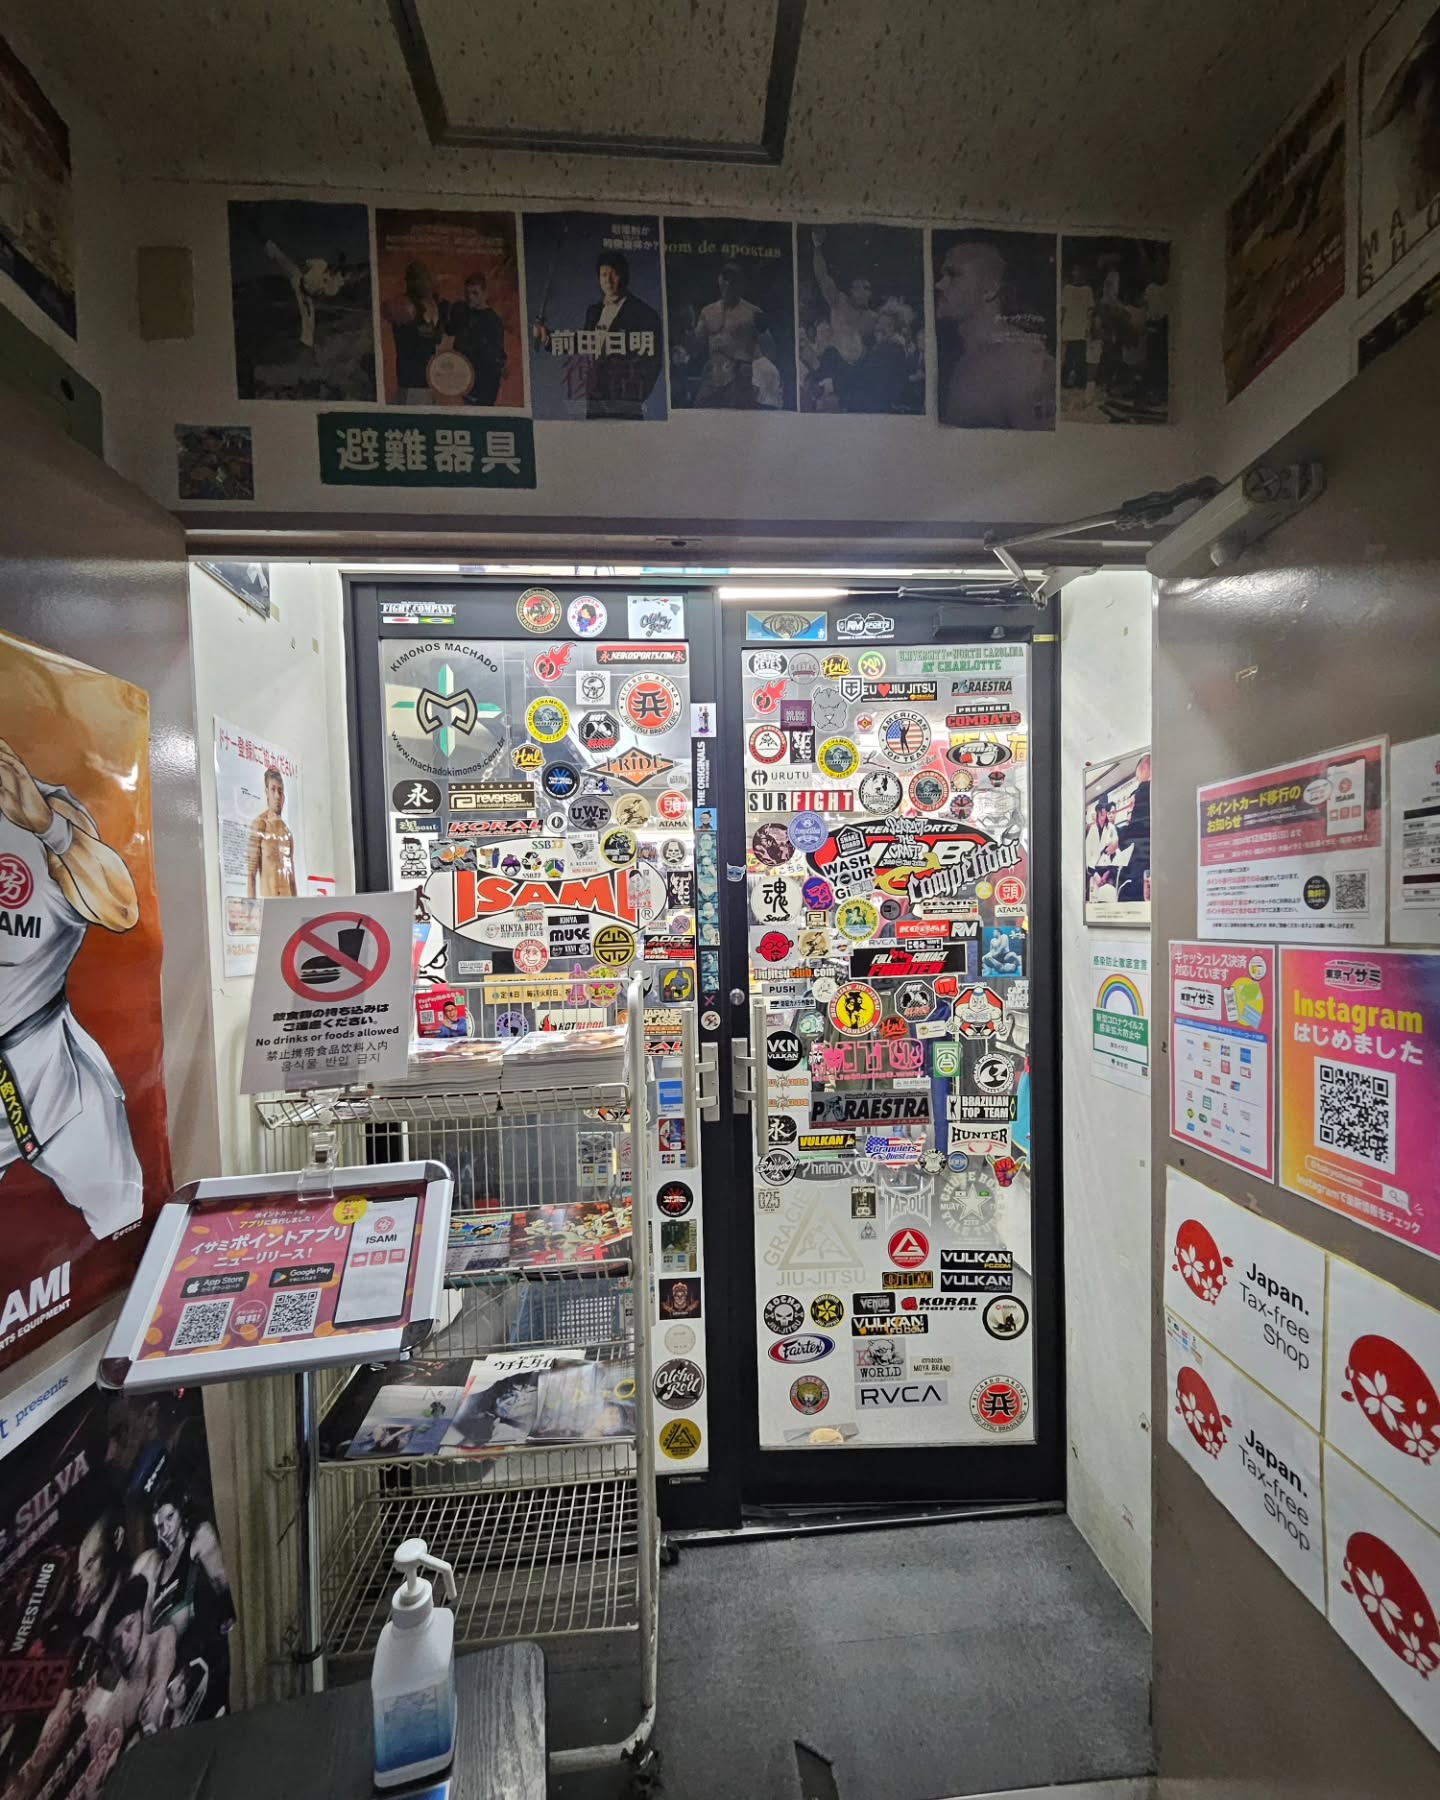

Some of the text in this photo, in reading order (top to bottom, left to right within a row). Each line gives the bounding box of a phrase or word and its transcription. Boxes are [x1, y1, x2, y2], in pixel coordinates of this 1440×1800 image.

[337, 428, 521, 473] 避難器具
[390, 643, 498, 673] KIMONOS MACHADO
[937, 660, 1002, 672] CHARLOTTE
[889, 684, 905, 694] JIU
[907, 683, 936, 694] JITSU
[882, 711, 928, 732] AMERICAN
[947, 713, 1020, 727] COMBATE
[391, 731, 506, 776] www.machadokimonos.com.br
[606, 754, 662, 772] PRIDE
[883, 745, 928, 762] TOP TEAM
[697, 741, 706, 807] THE ORIGINALS
[771, 771, 809, 780] URUTU
[1206, 816, 1242, 833] お知らせ
[823, 855, 871, 875] WASH
[762, 878, 789, 914] 魂
[500, 923, 543, 932] KINYA BOYZ
[764, 914, 791, 922] Soul
[1174, 952, 1248, 969] キャッシュレス決済
[1174, 964, 1230, 981] 対応しています
[1294, 990, 1424, 1035] Instagram
[255, 1025, 399, 1047] No drinks or foods allowed
[1294, 1022, 1424, 1066] はじめました
[961, 1096, 1009, 1106] BRAZILIAN
[962, 1107, 1009, 1118] TOP TEAM
[800, 1136, 844, 1147] VULKAN
[951, 1127, 1008, 1144] HUNTER
[190, 1226, 347, 1256] イサミポイントアプリ
[365, 1233, 398, 1245] ISAMI
[941, 1251, 1008, 1263] VULKAN
[203, 1275, 244, 1287] App Store
[289, 1266, 332, 1279] Google Play
[941, 1274, 1008, 1286] VULKAN
[1245, 1262, 1310, 1316] Japan.
[767, 1295, 801, 1311] ROCHA
[919, 1297, 978, 1306] KORAL
[17, 1298, 72, 1339] EQUIPMENT
[1239, 1281, 1311, 1346] Tax-free
[782, 1339, 823, 1360] Fairtex
[1263, 1323, 1311, 1370] Shop
[860, 1366, 902, 1378] WORLD
[15, 1374, 69, 1428] presents
[860, 1385, 942, 1405] RVCA
[1245, 1429, 1309, 1498] Japan.
[15, 1449, 91, 1539] SILVA
[1239, 1444, 1310, 1527] Tax-free
[1264, 1497, 1311, 1553] Shop
[9, 1562, 56, 1654] WRESTLING
